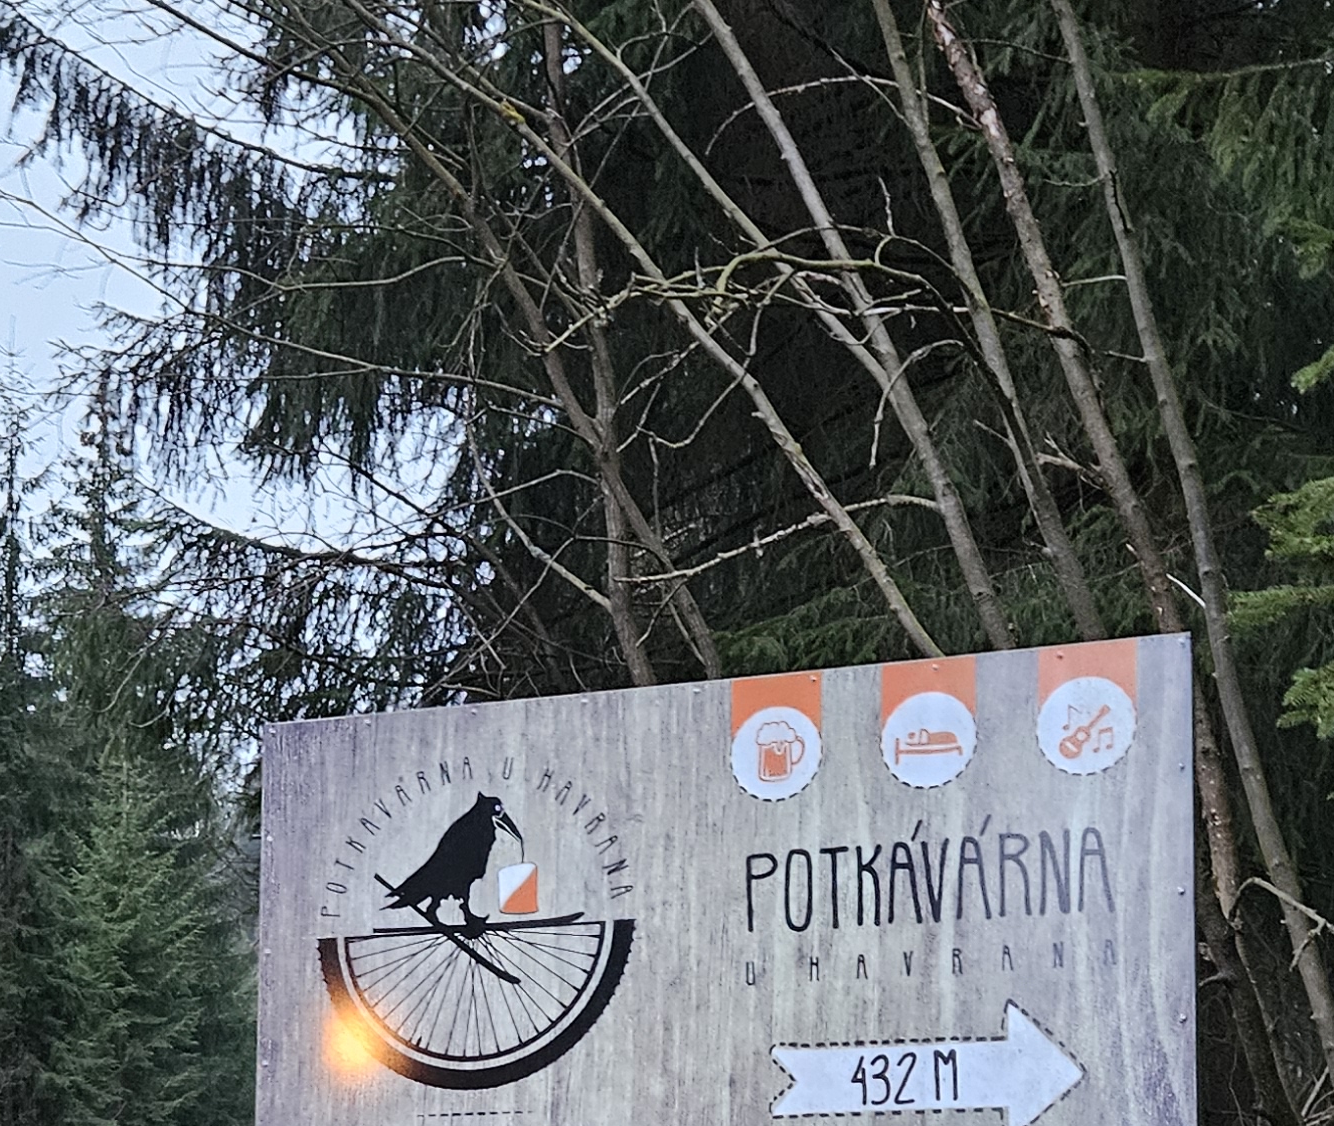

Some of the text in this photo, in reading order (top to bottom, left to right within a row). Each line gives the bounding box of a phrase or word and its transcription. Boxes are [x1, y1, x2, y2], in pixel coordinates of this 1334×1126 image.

[504, 757, 513, 780] U
[536, 767, 634, 900] HAVRANA
[745, 814, 1115, 932] POTKÁVÁRNA
[745, 939, 1117, 986] U HAVRANA
[851, 1049, 958, 1105] 432 M
